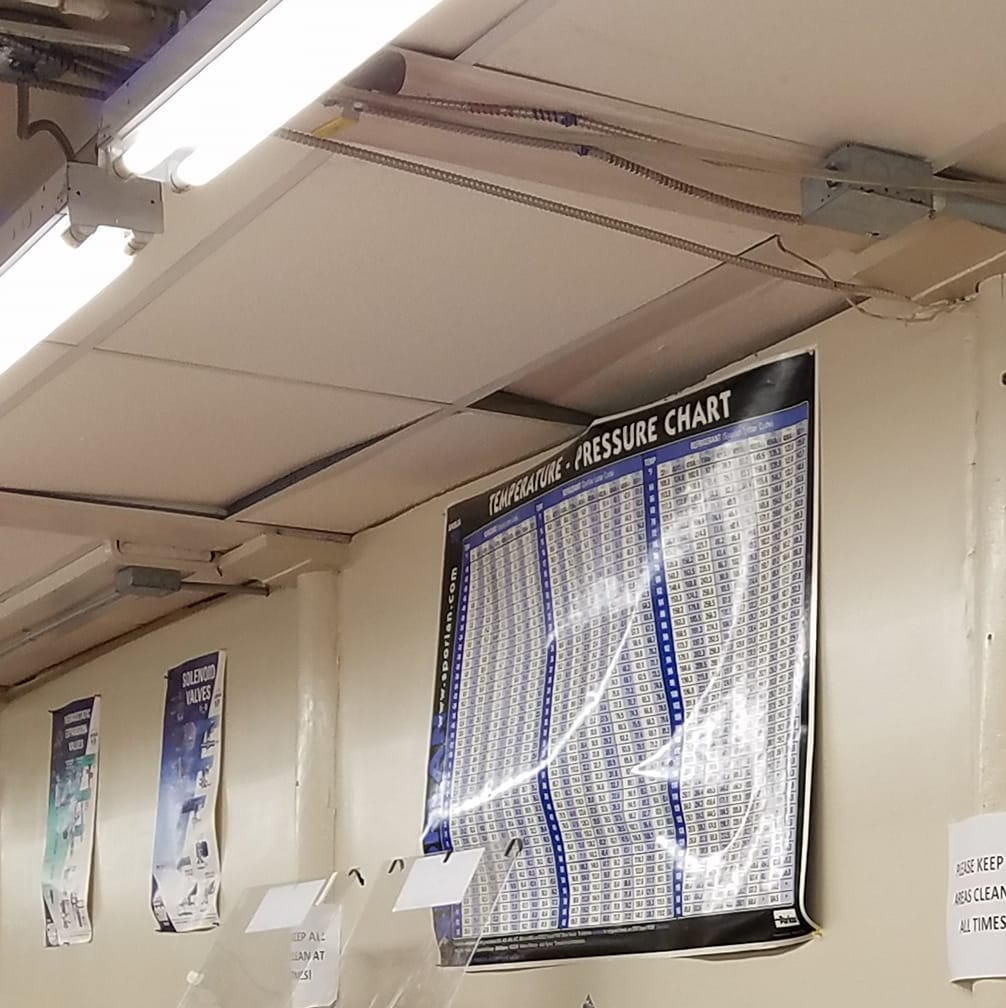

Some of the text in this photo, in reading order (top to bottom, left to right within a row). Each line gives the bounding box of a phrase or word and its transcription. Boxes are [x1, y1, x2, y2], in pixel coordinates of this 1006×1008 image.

[487, 456, 563, 517] TEMPERATURE
[574, 415, 658, 471] PRESSURE
[664, 389, 733, 436] CHART
[186, 684, 212, 706] VALVES
[977, 855, 1004, 873] KEEP
[960, 918, 971, 933] ALL
[312, 950, 325, 961] AT
